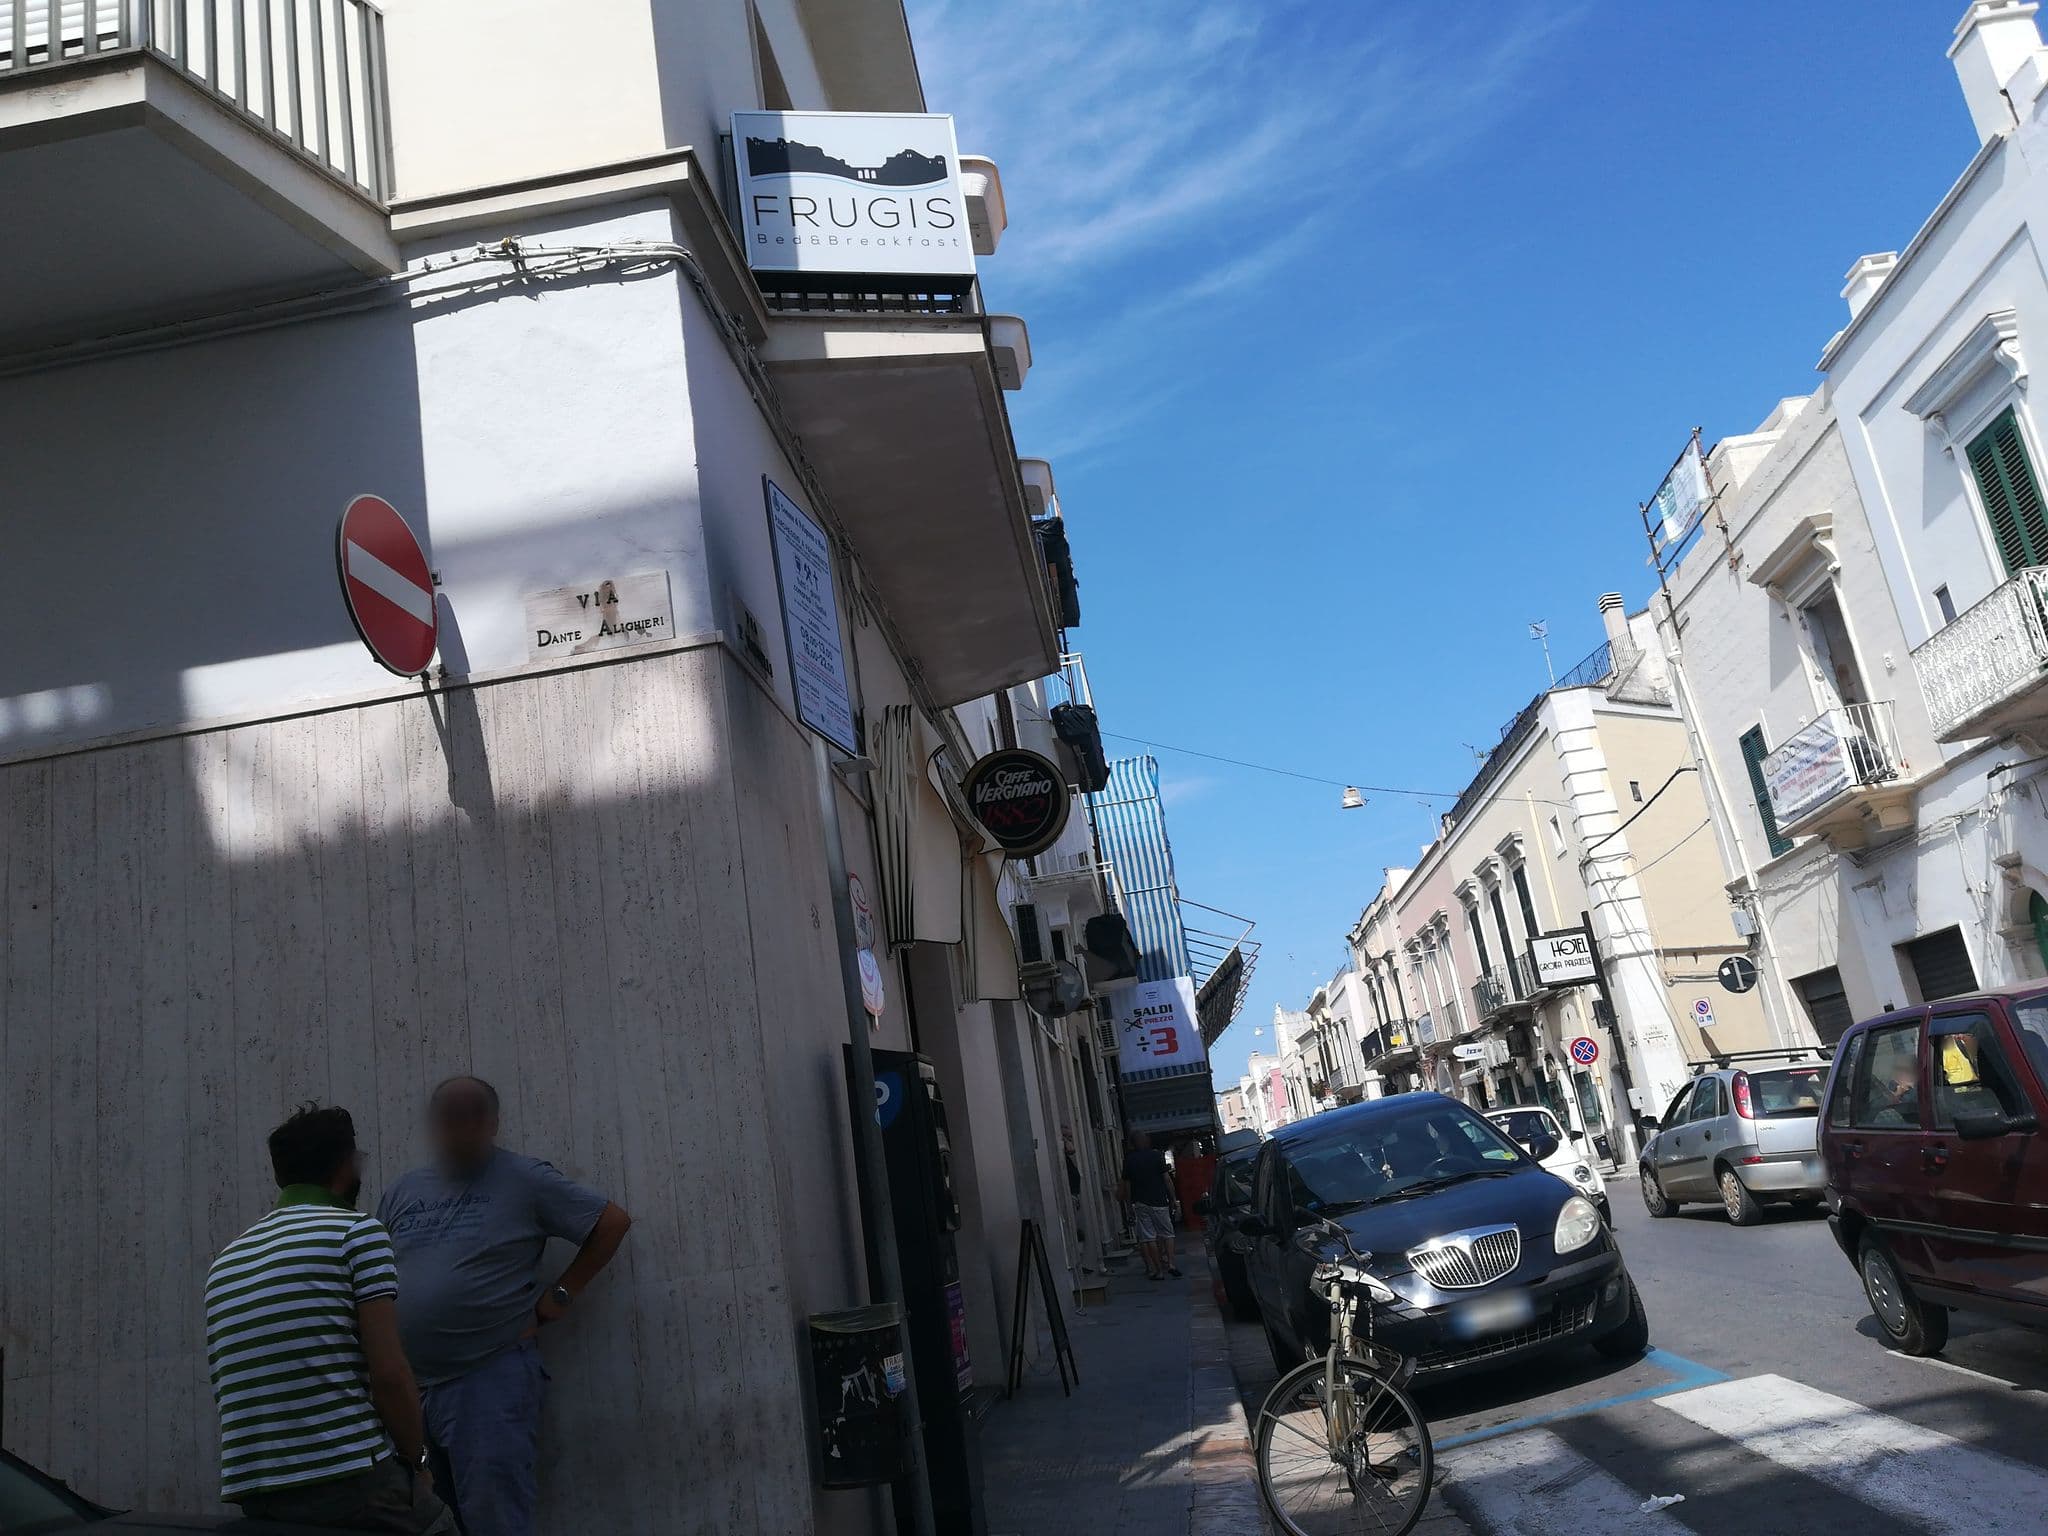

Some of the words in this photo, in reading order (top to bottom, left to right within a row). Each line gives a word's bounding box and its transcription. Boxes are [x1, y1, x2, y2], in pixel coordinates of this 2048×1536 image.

[752, 195, 955, 229] FRUGIS
[757, 233, 960, 247] Bed&Breakfast
[576, 589, 618, 609] VIA
[975, 779, 1052, 803] VERGNANO
[1550, 938, 1588, 957] HOTEL
[1133, 1003, 1173, 1018] SALDI
[1144, 1015, 1174, 1025] PREZZO
